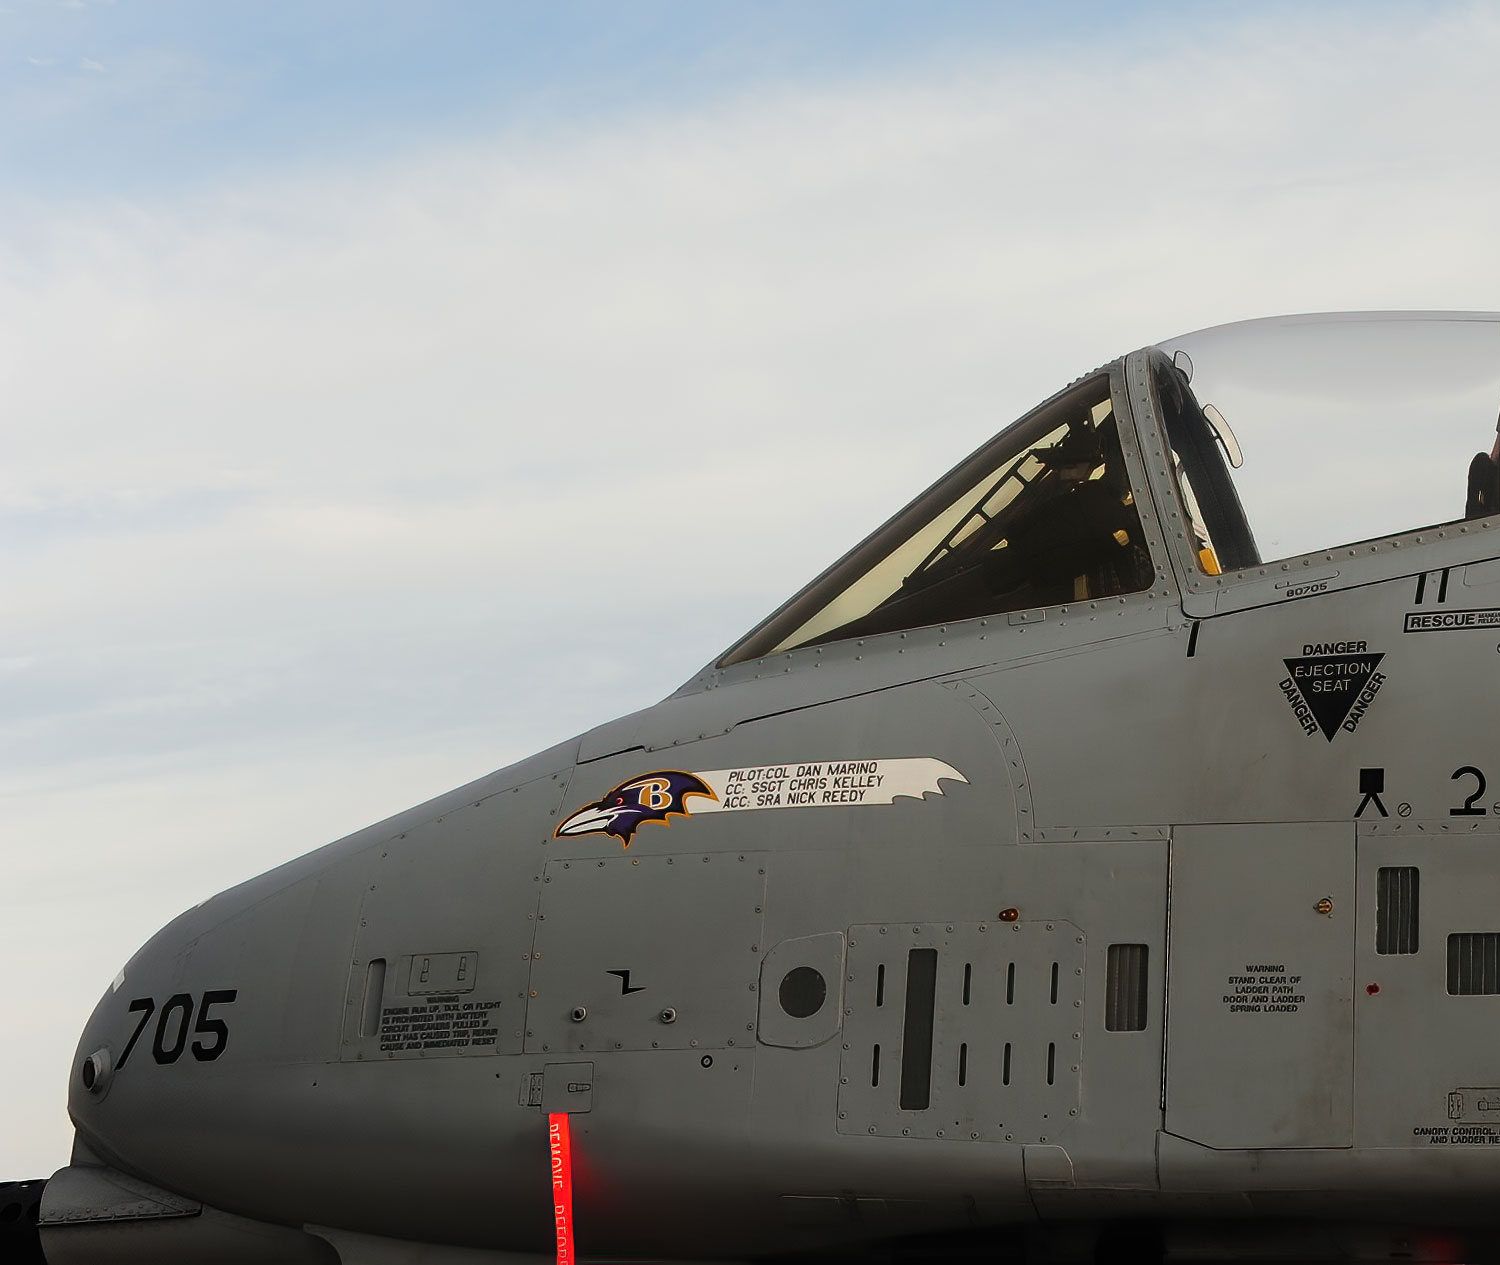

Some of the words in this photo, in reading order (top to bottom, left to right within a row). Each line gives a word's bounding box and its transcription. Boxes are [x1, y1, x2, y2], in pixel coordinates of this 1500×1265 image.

[1286, 581, 1328, 597] 80705
[1410, 613, 1475, 628] RESCUE
[1302, 640, 1367, 656] DANGER
[1295, 662, 1371, 677] EJECTION
[1312, 679, 1351, 692] SEAT
[1279, 677, 1318, 736] DANGER
[1342, 672, 1386, 733] DANGER
[796, 764, 822, 777] DAN
[827, 761, 878, 775] MARINO
[725, 784, 745, 796] CC:
[751, 780, 784, 793] SSGT
[789, 778, 826, 791] CHRIS
[833, 775, 885, 789] KELLEY
[723, 796, 750, 809] ACC:
[757, 794, 781, 806] SRA
[787, 792, 816, 805] NICK
[822, 790, 865, 803] REEDY
[1246, 964, 1285, 973] WARNING
[1228, 976, 1256, 984] STAND
[1258, 976, 1287, 984] CLEAR
[1289, 975, 1302, 984] OF
[1235, 986, 1269, 994] LADDER
[1271, 986, 1294, 994] PATH
[1222, 995, 1248, 1004] DOOR
[1250, 995, 1269, 1004] AND
[1271, 995, 1306, 1004] LADDER
[411, 1006, 428, 1014] RUN
[475, 1001, 501, 1010] FLIGHT
[1230, 1004, 1261, 1013] SPRING
[1263, 1004, 1298, 1013] LOADED
[391, 1014, 434, 1024] PROHIBITED
[435, 1012, 454, 1021] WITH
[455, 1011, 488, 1020] BATTERY
[114, 989, 238, 1071] 705
[381, 1025, 410, 1033] CIRCUIT
[412, 1022, 450, 1032] BREAKERS
[452, 1020, 480, 1029] PULLED
[381, 1033, 402, 1042] FAULT
[403, 1032, 419, 1041] HAS
[420, 1030, 450, 1040] CAUSED
[472, 1029, 498, 1037] REPAIR
[380, 1042, 404, 1051] CAUSE
[405, 1041, 422, 1050] AND
[423, 1039, 470, 1049] IMMEDIATELY
[472, 1037, 496, 1046] RESET
[1413, 1127, 1450, 1135] CANOPY
[1430, 1136, 1448, 1144] AND
[1450, 1136, 1486, 1144] LADDER
